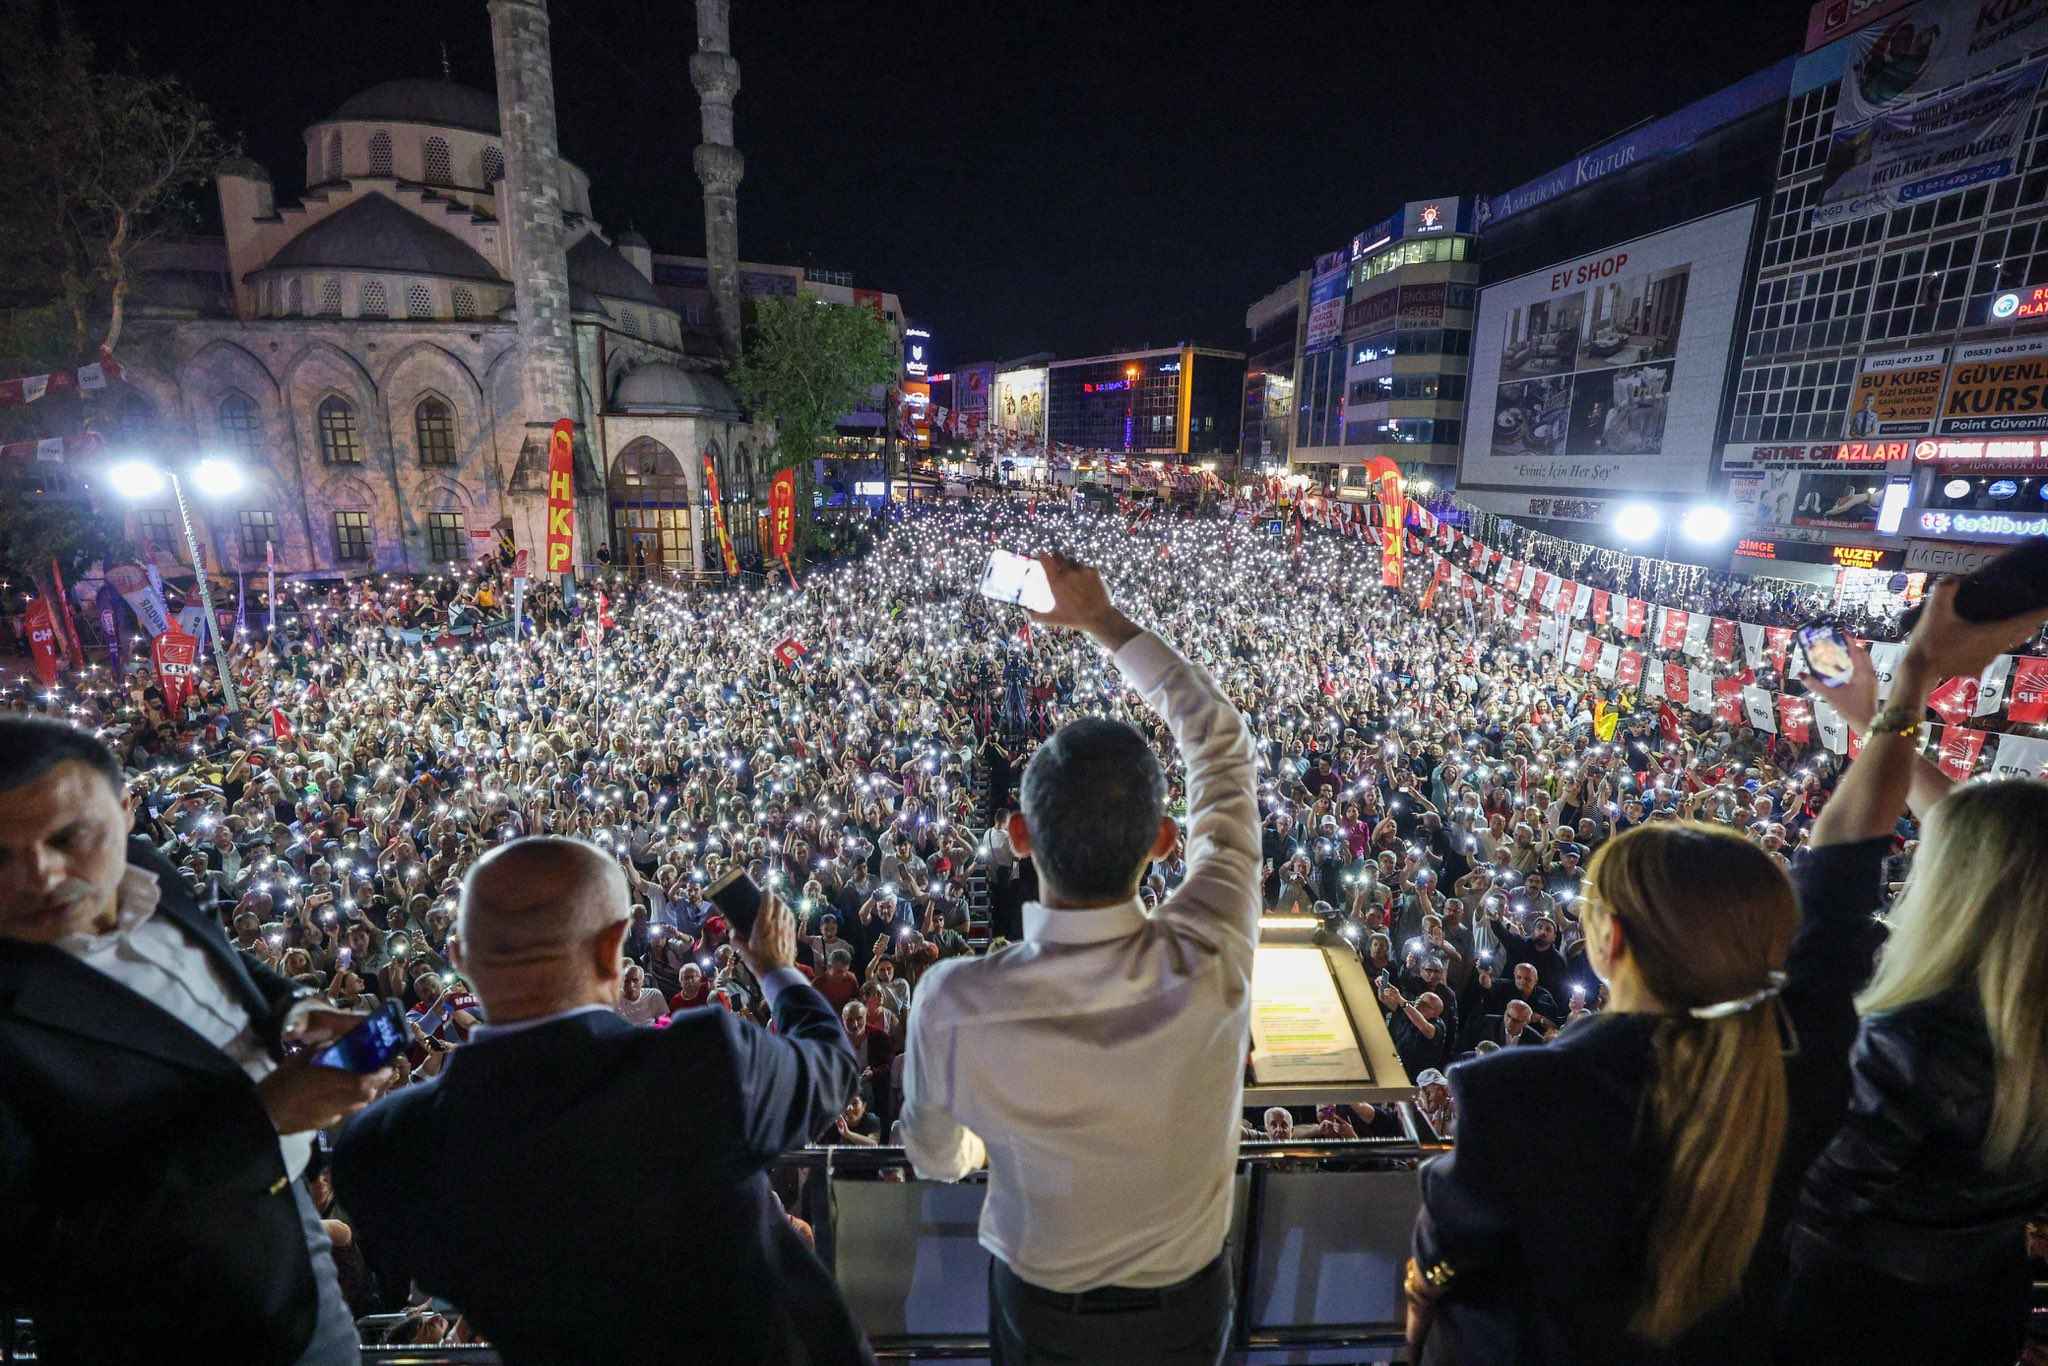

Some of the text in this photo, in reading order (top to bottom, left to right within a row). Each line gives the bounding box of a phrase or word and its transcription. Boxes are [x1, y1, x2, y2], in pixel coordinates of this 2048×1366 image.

[1552, 253, 1628, 292] EV SHOP
[1861, 370, 1940, 389] BU KURS
[1958, 363, 2048, 385] GÜVENL
[1951, 419, 1986, 431] Point
[1570, 464, 1590, 477] Her
[550, 470, 573, 571] HKP
[778, 507, 790, 545] HKP
[1738, 540, 1775, 552] SİMGE
[1833, 547, 1883, 562] KUZEY
[32, 630, 53, 642] CH
